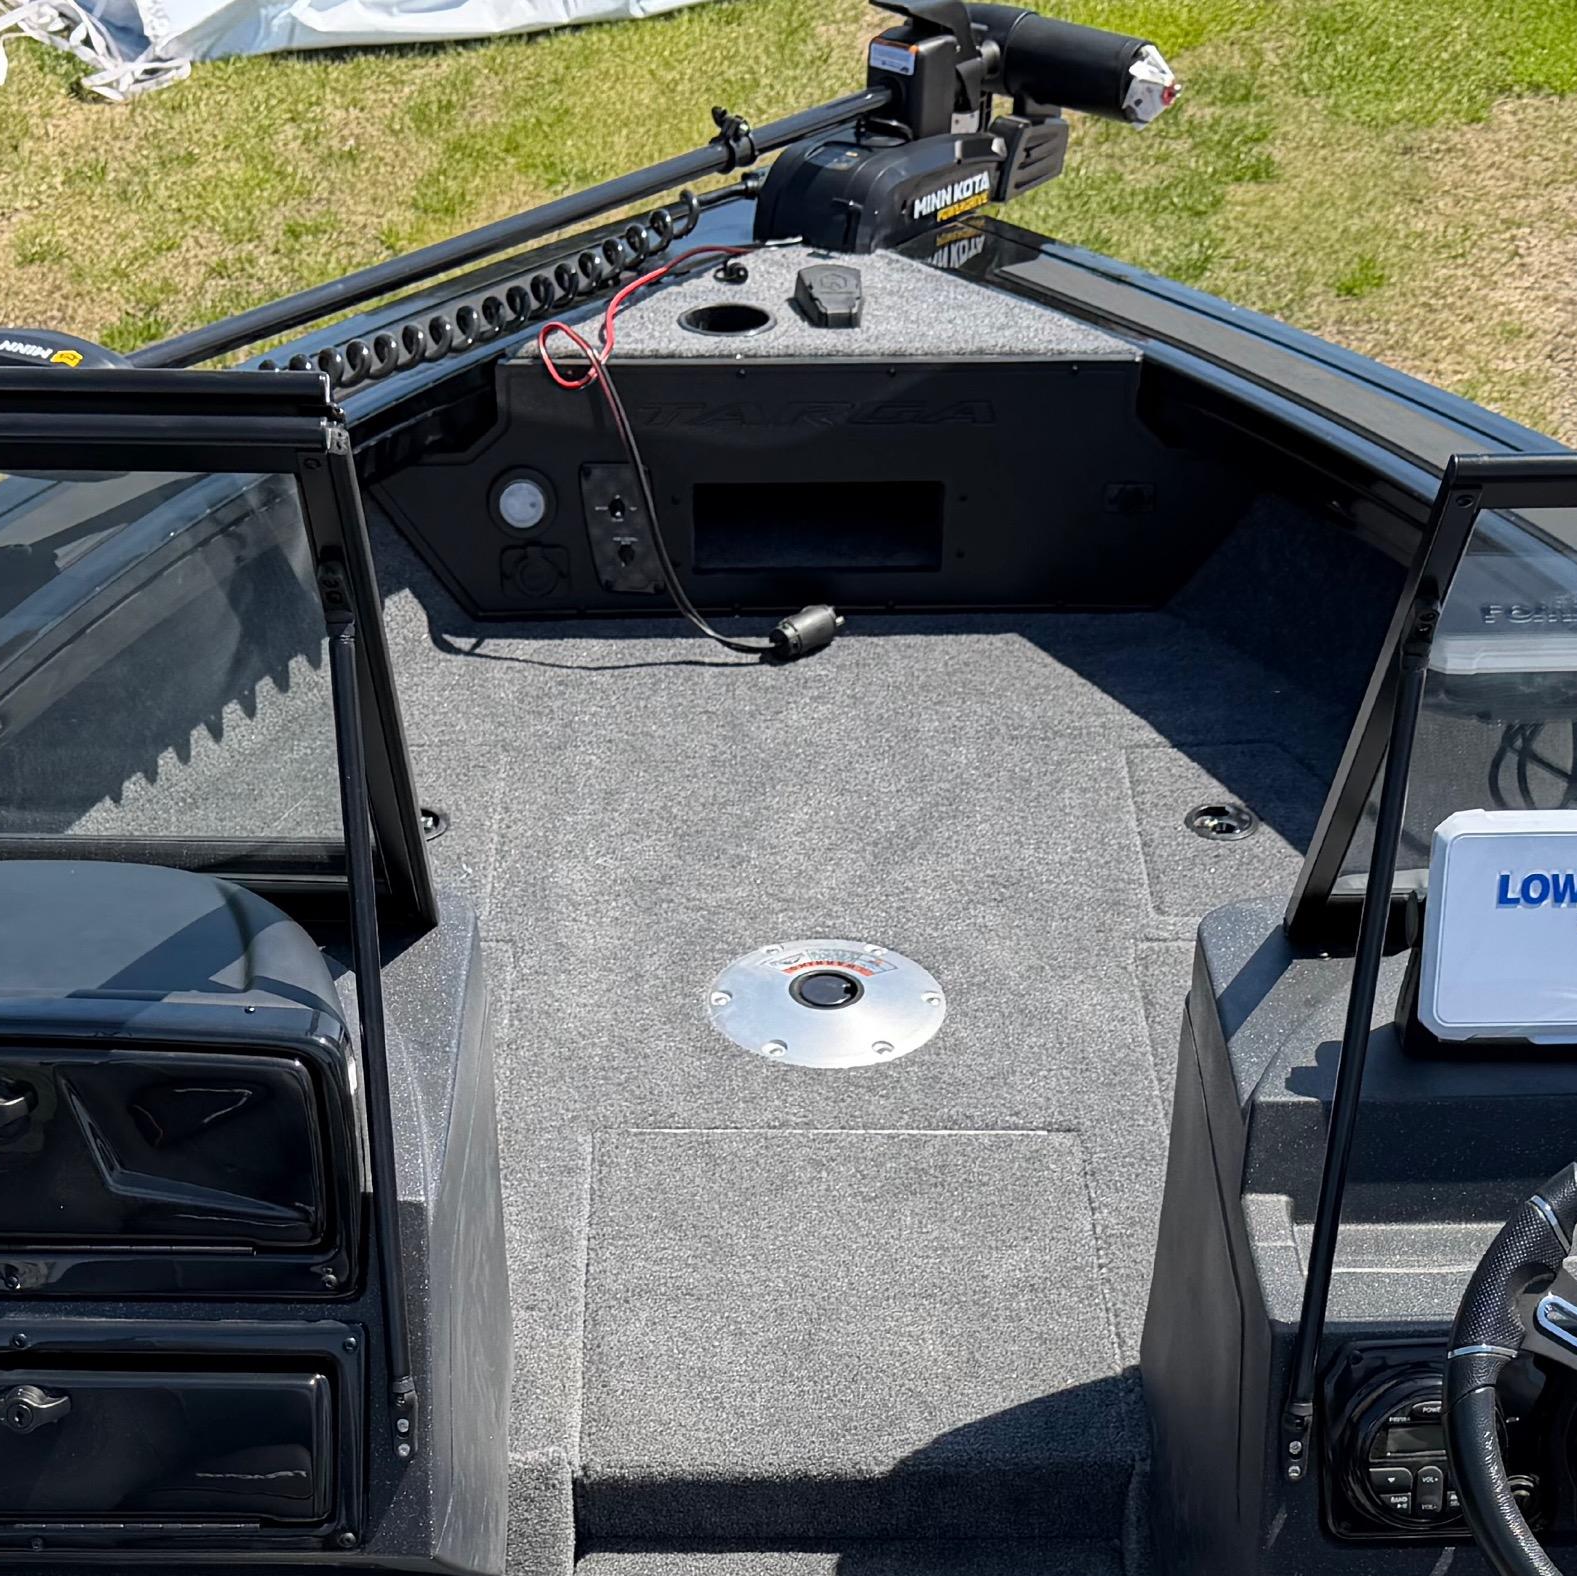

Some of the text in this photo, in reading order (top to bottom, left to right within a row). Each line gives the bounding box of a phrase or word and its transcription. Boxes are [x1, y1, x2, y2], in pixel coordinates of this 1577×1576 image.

[914, 171, 990, 219] MINN KOTA
[638, 401, 998, 428] TARGA
